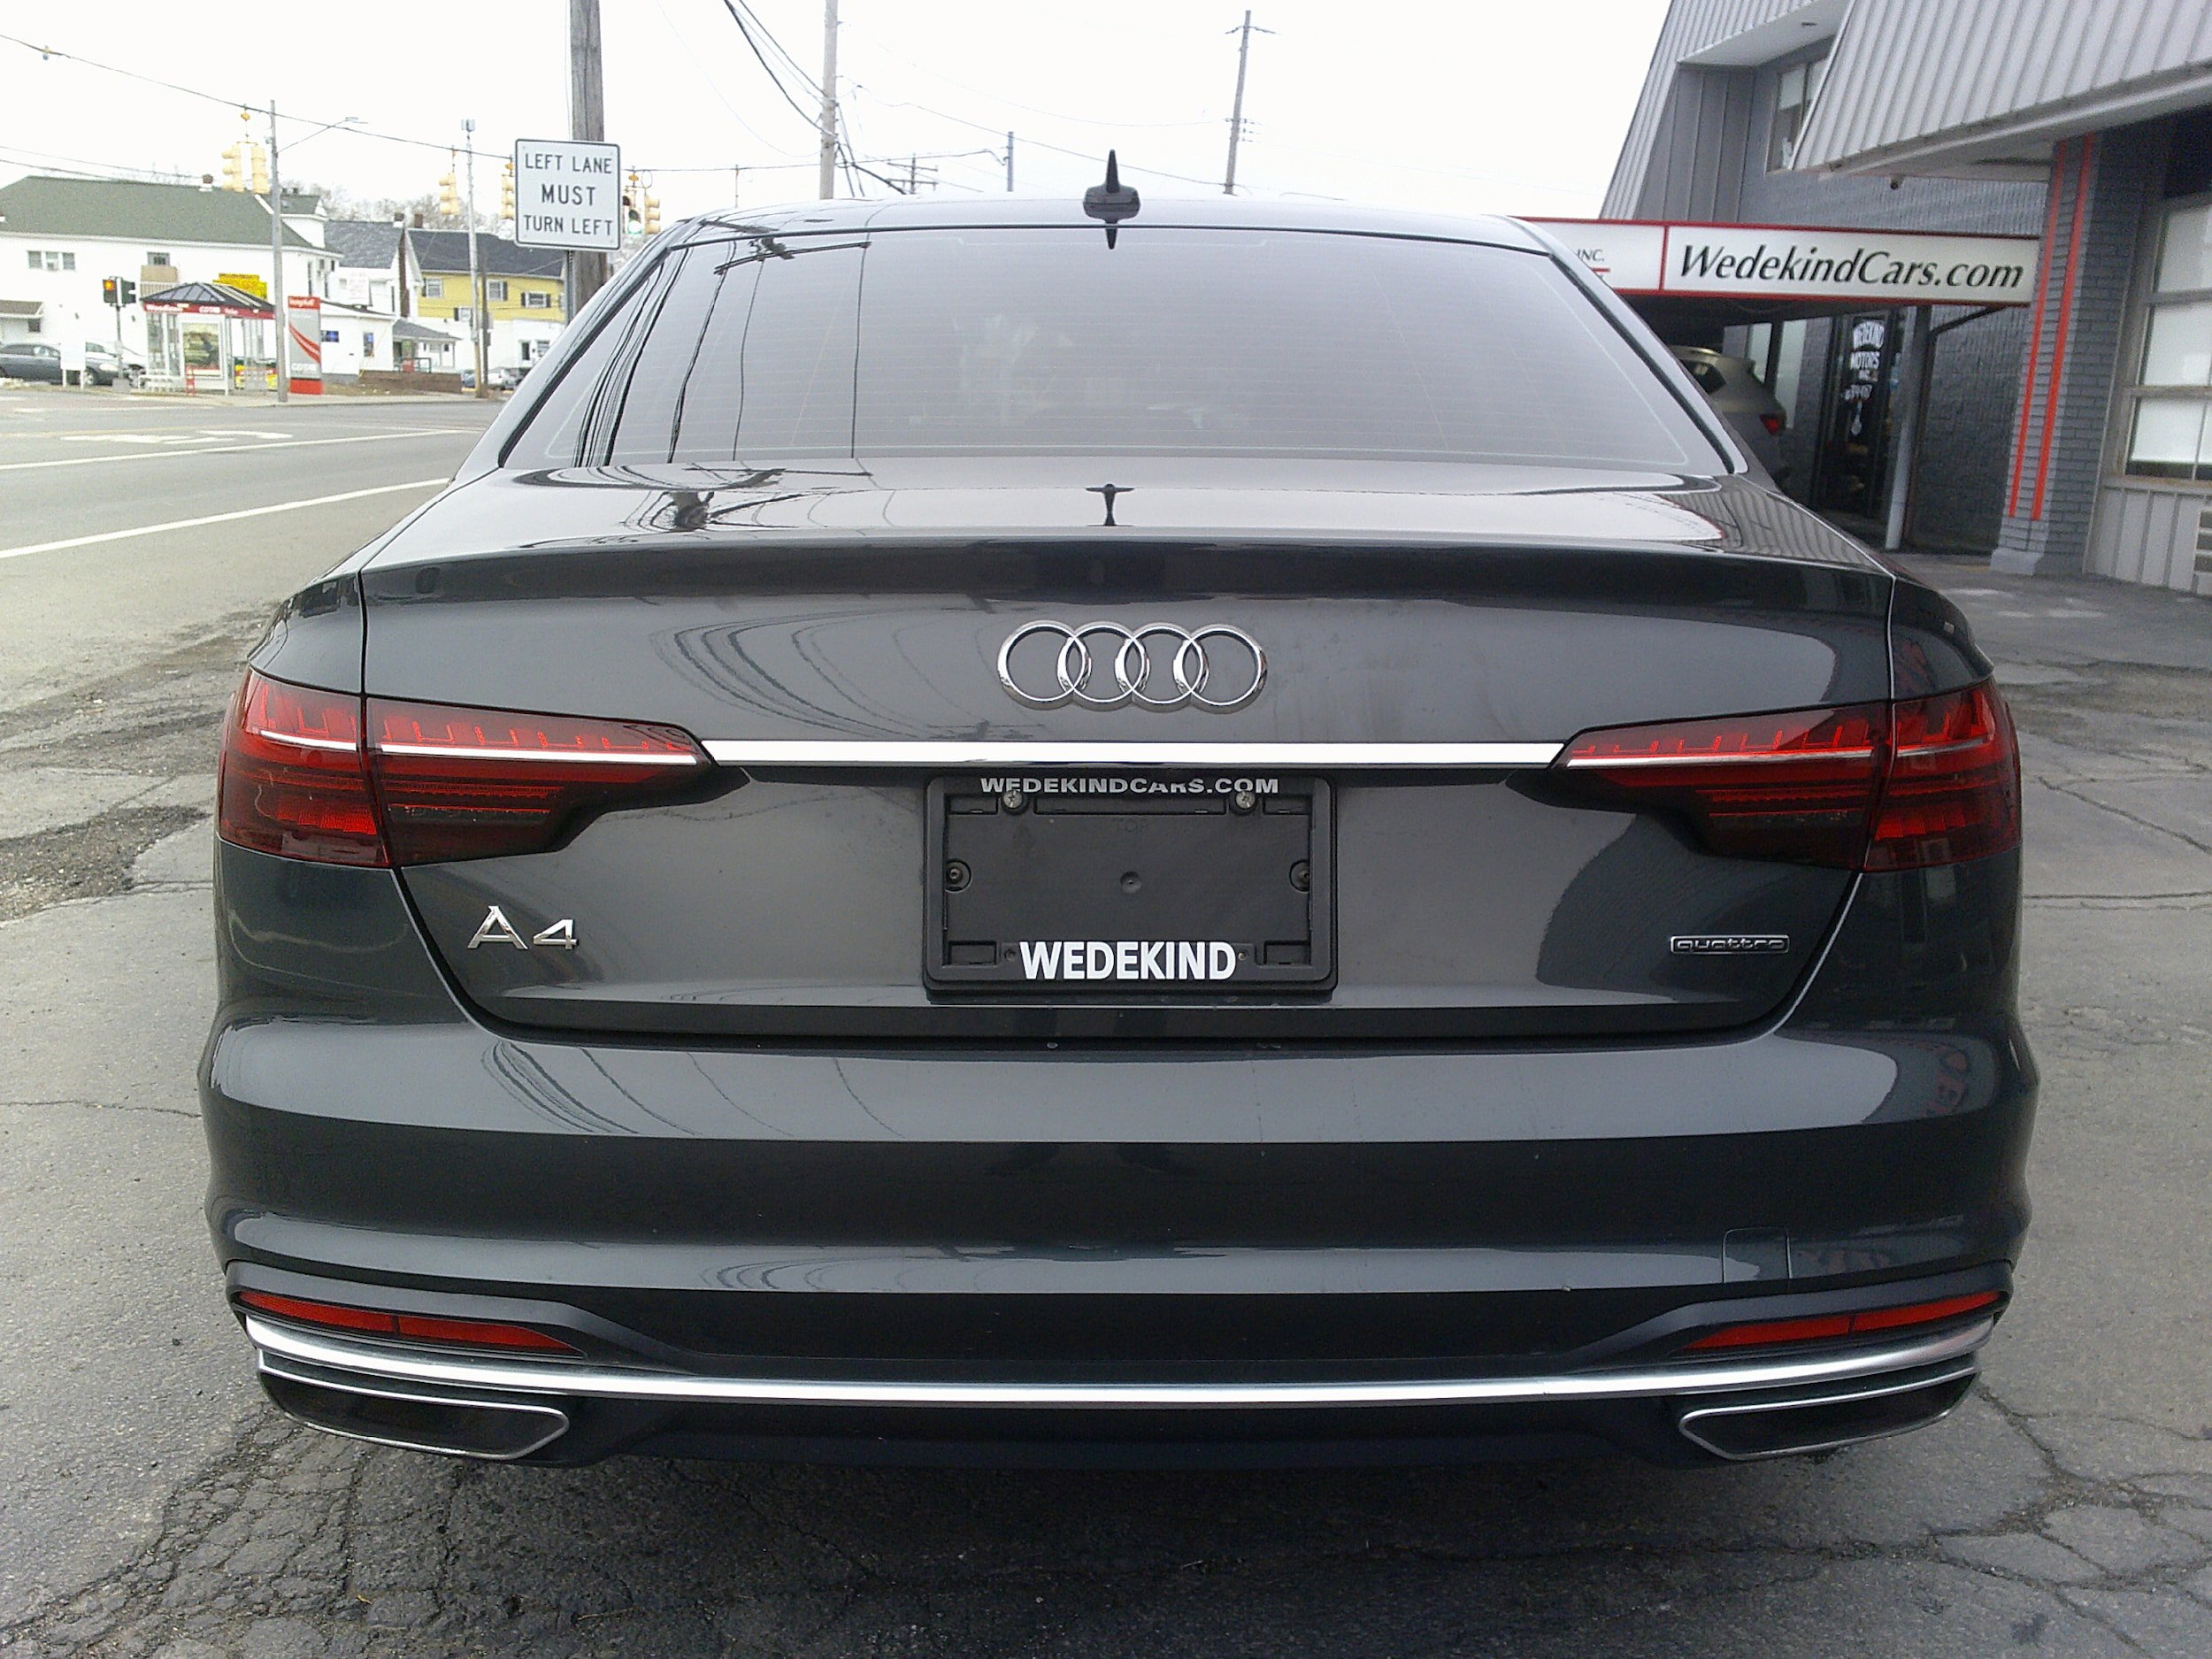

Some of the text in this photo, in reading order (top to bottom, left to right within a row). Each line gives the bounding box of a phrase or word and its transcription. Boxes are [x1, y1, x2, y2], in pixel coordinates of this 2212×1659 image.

[525, 153, 612, 174] LEFT LANE
[541, 183, 596, 206] MUST
[523, 215, 612, 236] TURN LEFT
[1679, 243, 2024, 289] WedekindCars.com
[980, 777, 1279, 795] WEDEKINDCARS.COM
[467, 905, 579, 950] A4
[1677, 938, 1785, 952] quattro
[1018, 941, 1237, 980] WEDEKIND
